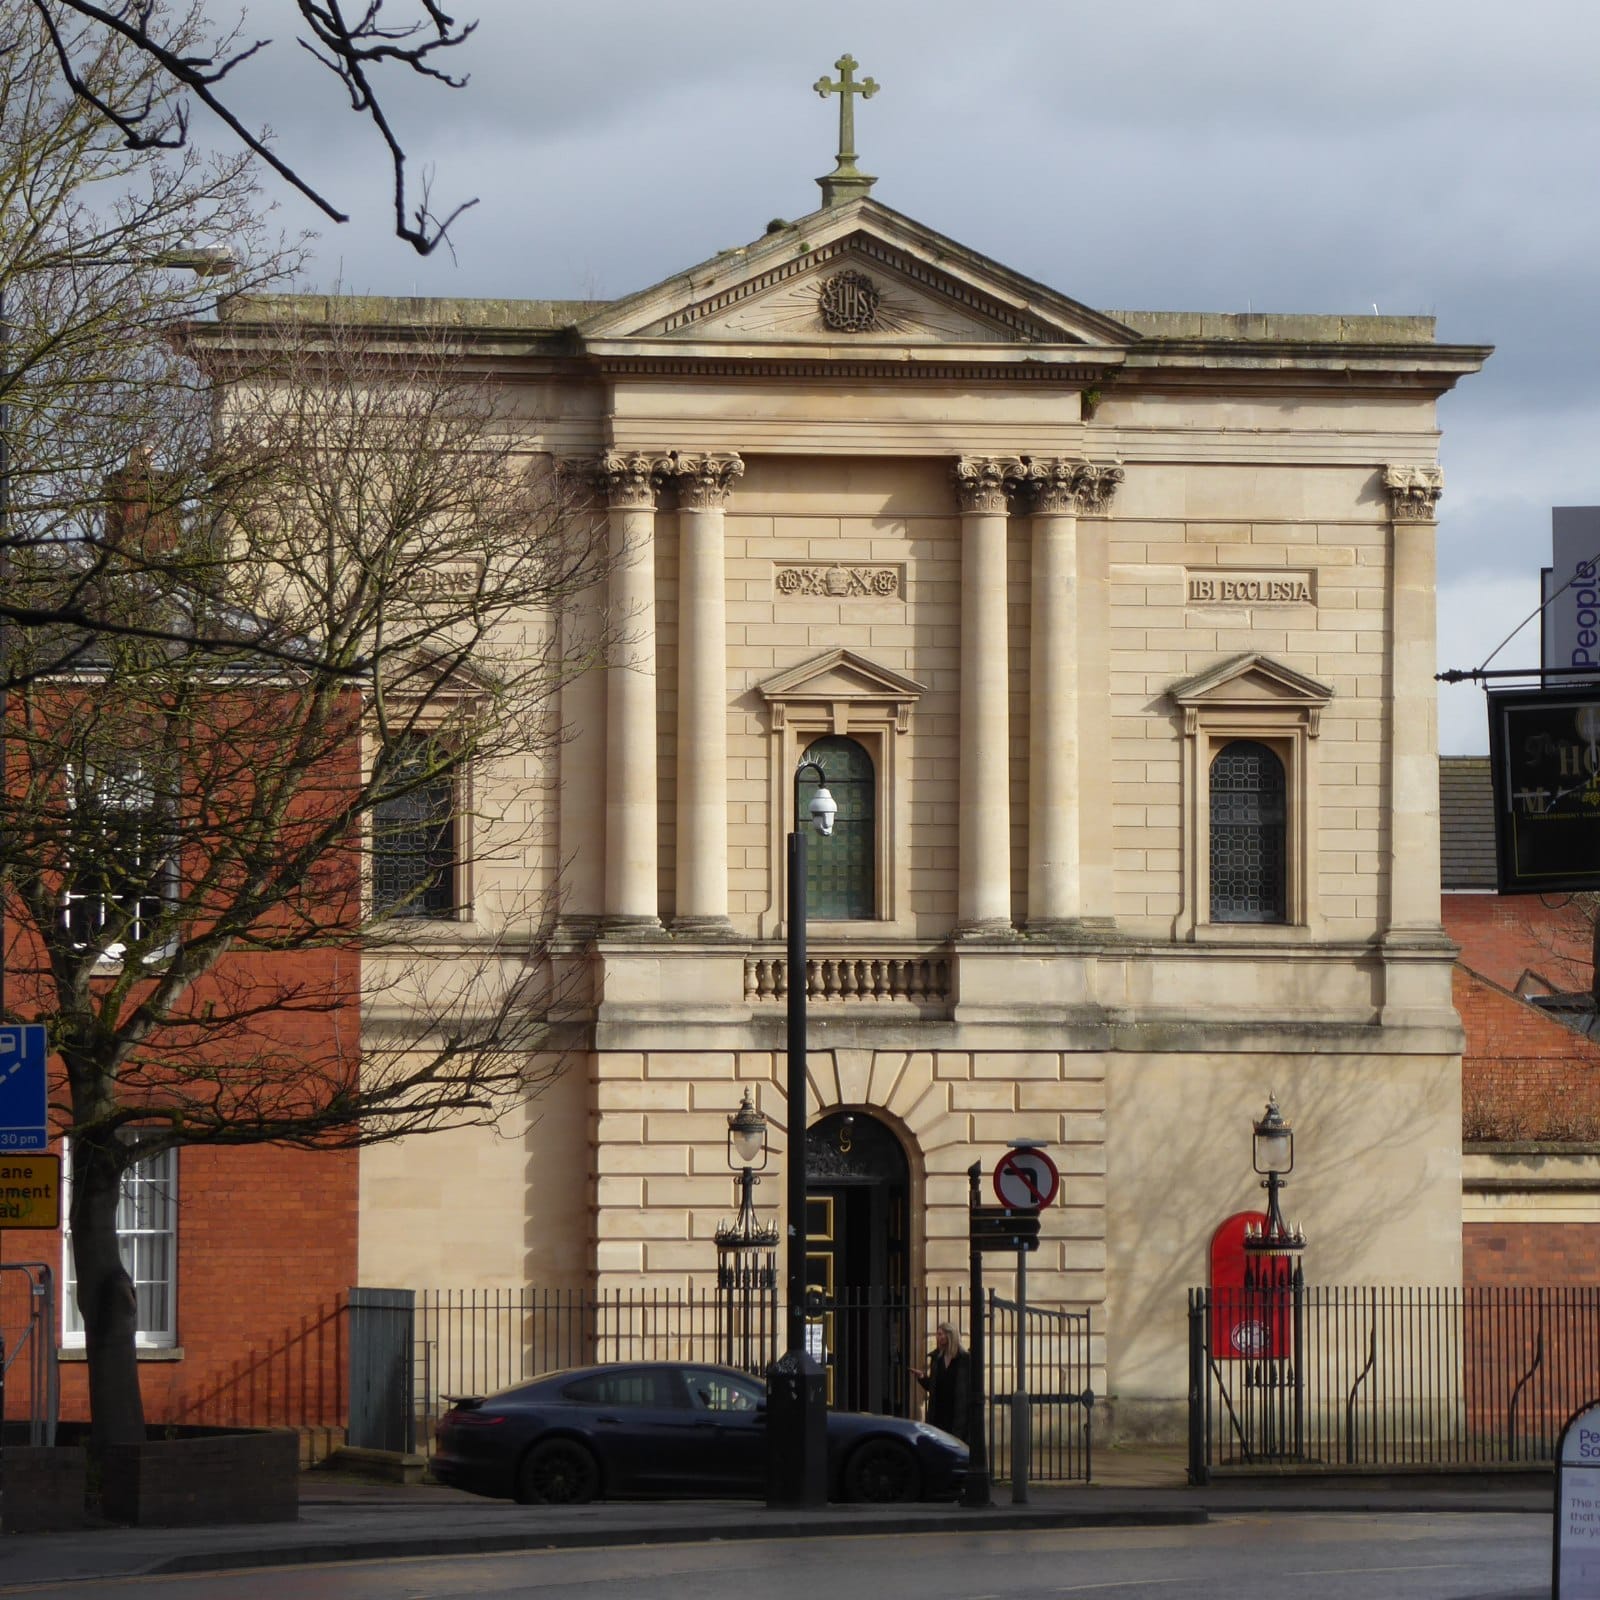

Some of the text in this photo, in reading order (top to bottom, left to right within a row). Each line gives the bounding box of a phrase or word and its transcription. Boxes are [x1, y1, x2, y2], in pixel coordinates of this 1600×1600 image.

[784, 572, 798, 588] 18
[1189, 580, 1312, 601] IBI ECCLESIA
[1570, 560, 1600, 667] People
[20, 1135, 38, 1146] pm
[1570, 1498, 1592, 1508] The
[1570, 1511, 1594, 1521] that
[1570, 1525, 1586, 1536] for
